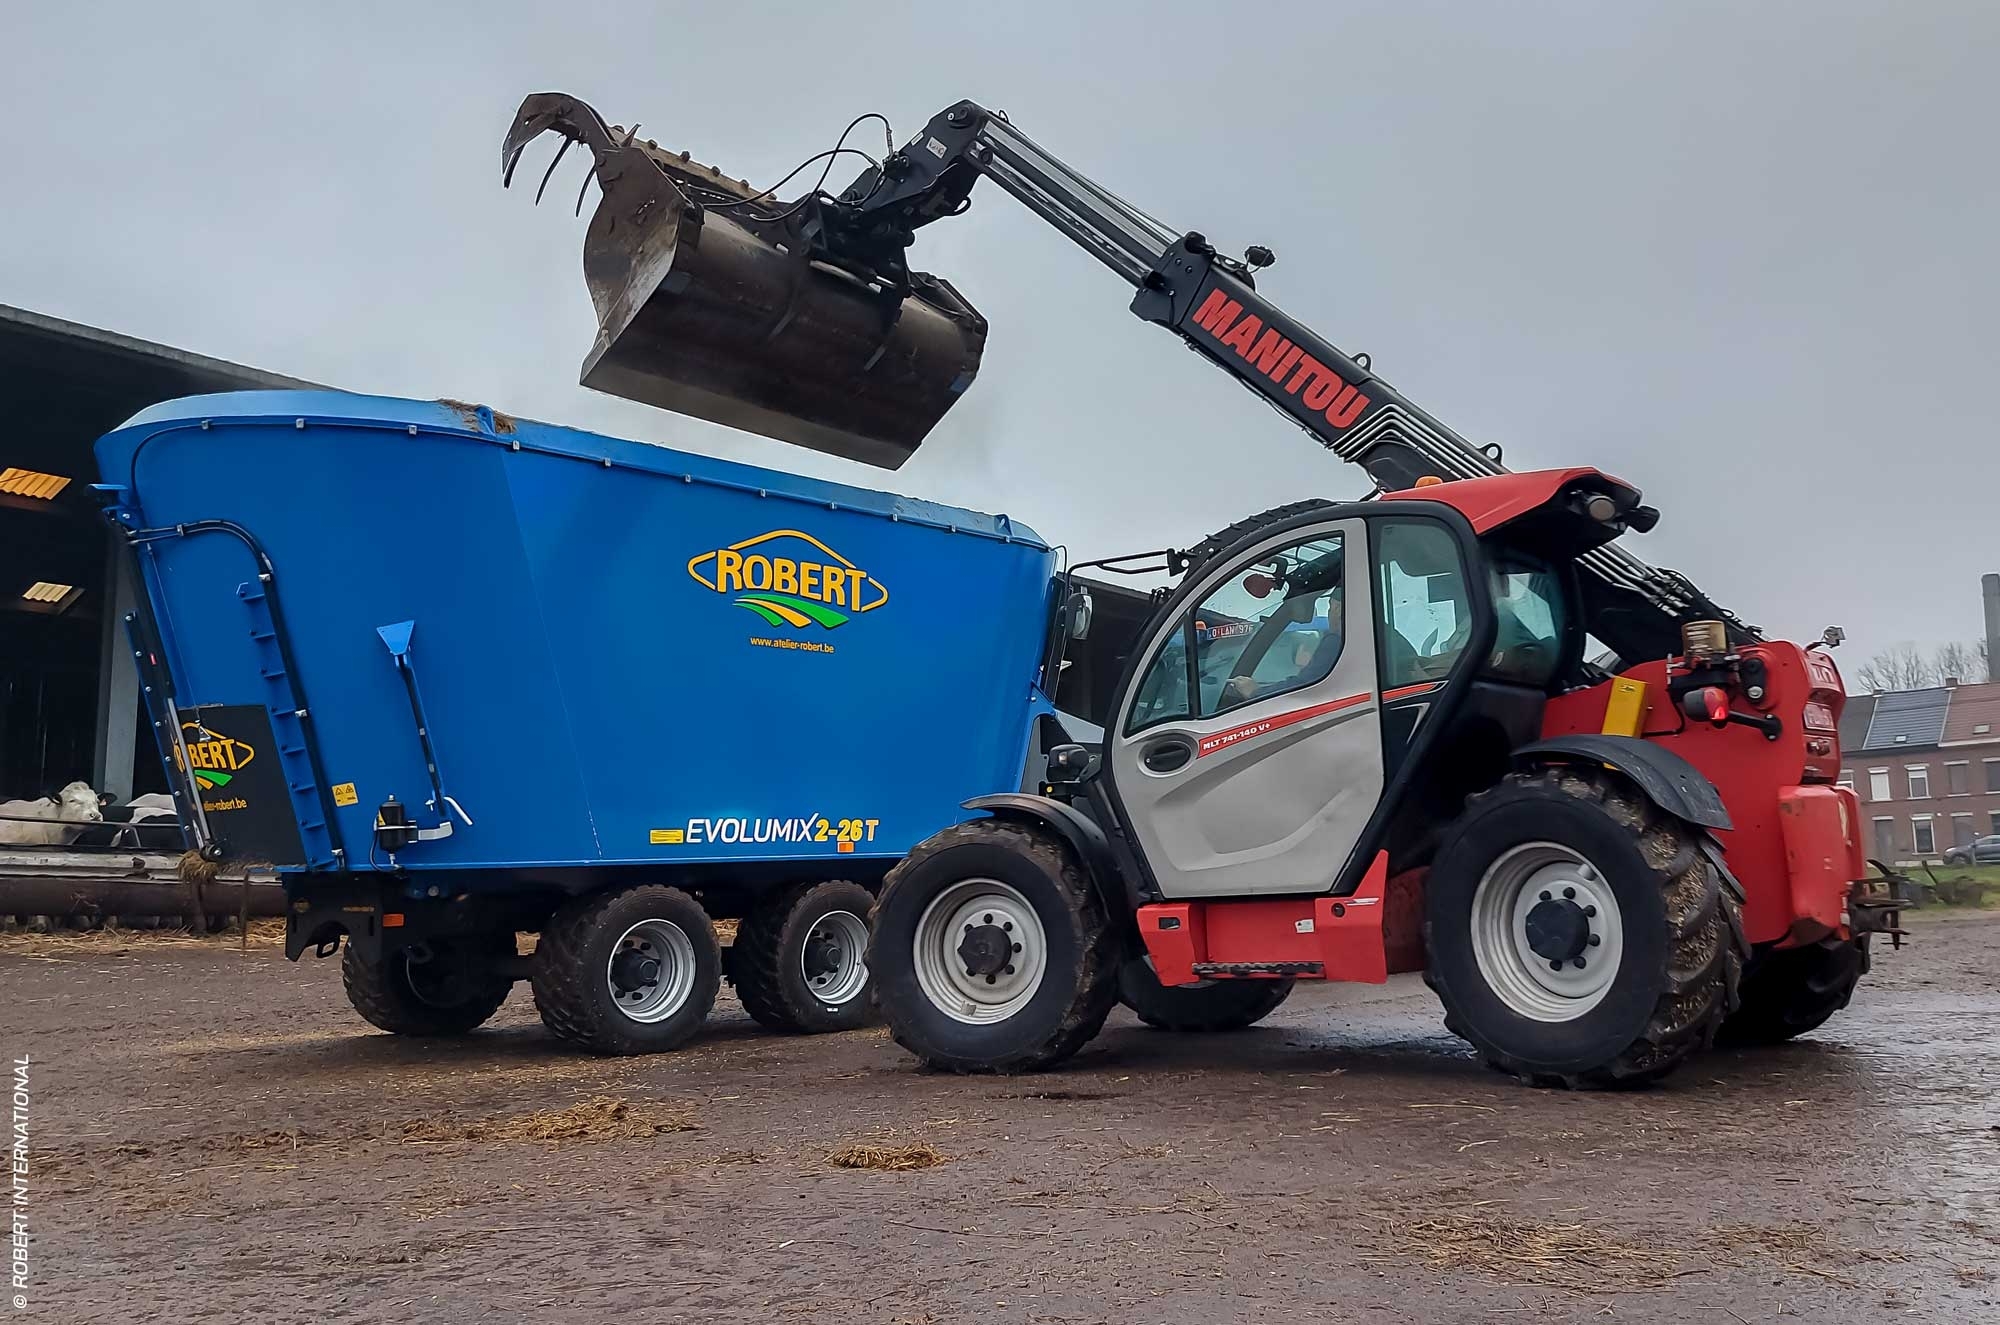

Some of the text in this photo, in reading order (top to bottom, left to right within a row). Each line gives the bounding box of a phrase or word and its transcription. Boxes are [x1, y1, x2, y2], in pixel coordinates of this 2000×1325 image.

[1192, 288, 1371, 428] MANITOU
[716, 549, 867, 612] ROBERT
[750, 636, 835, 654] www.atelier-robert.be
[1203, 738, 1221, 750] MLT
[1221, 727, 1258, 744] 741-140
[173, 738, 237, 773] RBERT
[686, 813, 819, 843] EVOLUMIX
